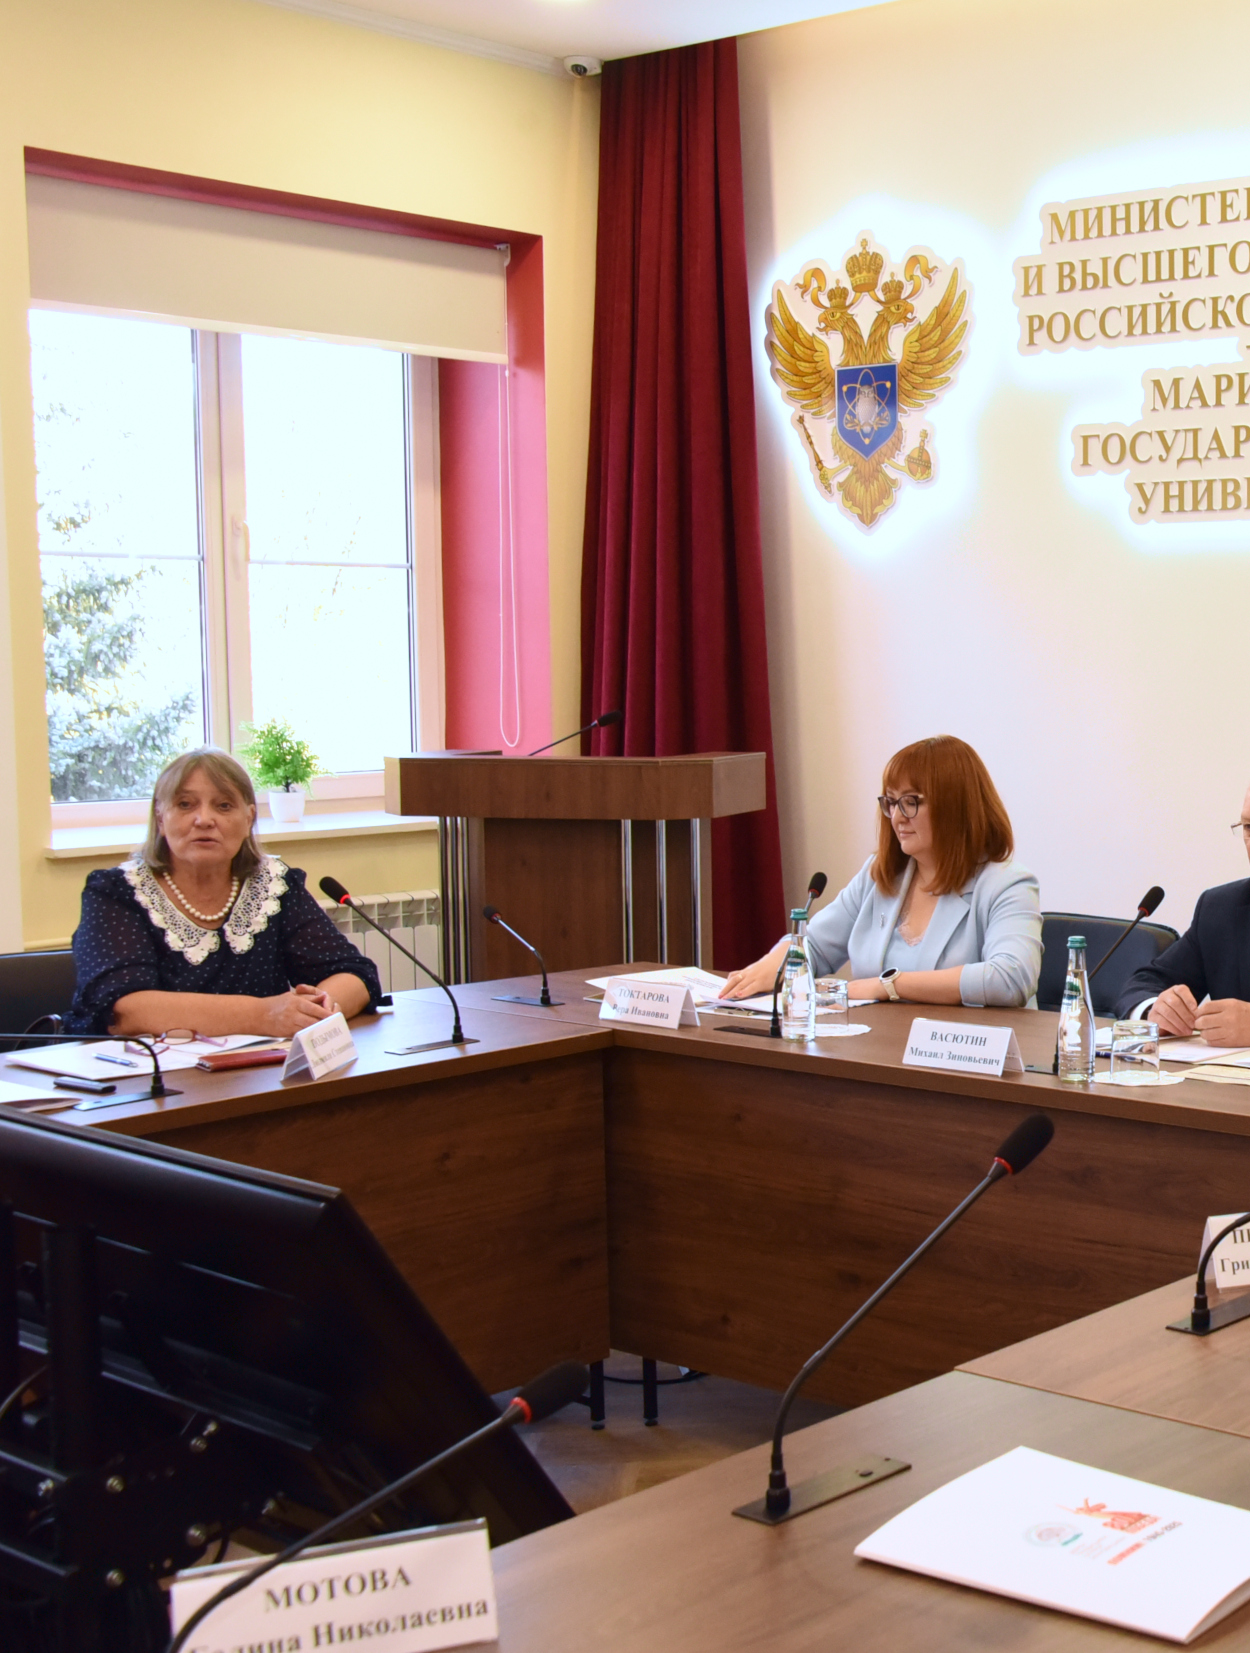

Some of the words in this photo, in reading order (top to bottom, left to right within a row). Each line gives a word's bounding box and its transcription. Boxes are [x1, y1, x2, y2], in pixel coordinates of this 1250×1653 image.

[1021, 263, 1047, 298] И
[618, 988, 670, 1003] ТОКТАРОВА
[631, 1006, 670, 1020] Ивановна
[930, 1031, 987, 1047] ВАСЮТИН
[908, 1046, 944, 1060] Михаил
[946, 1051, 1000, 1066] Зиновьевич
[264, 1564, 412, 1613] МОТОВА
[311, 1598, 489, 1649] Николаевна
